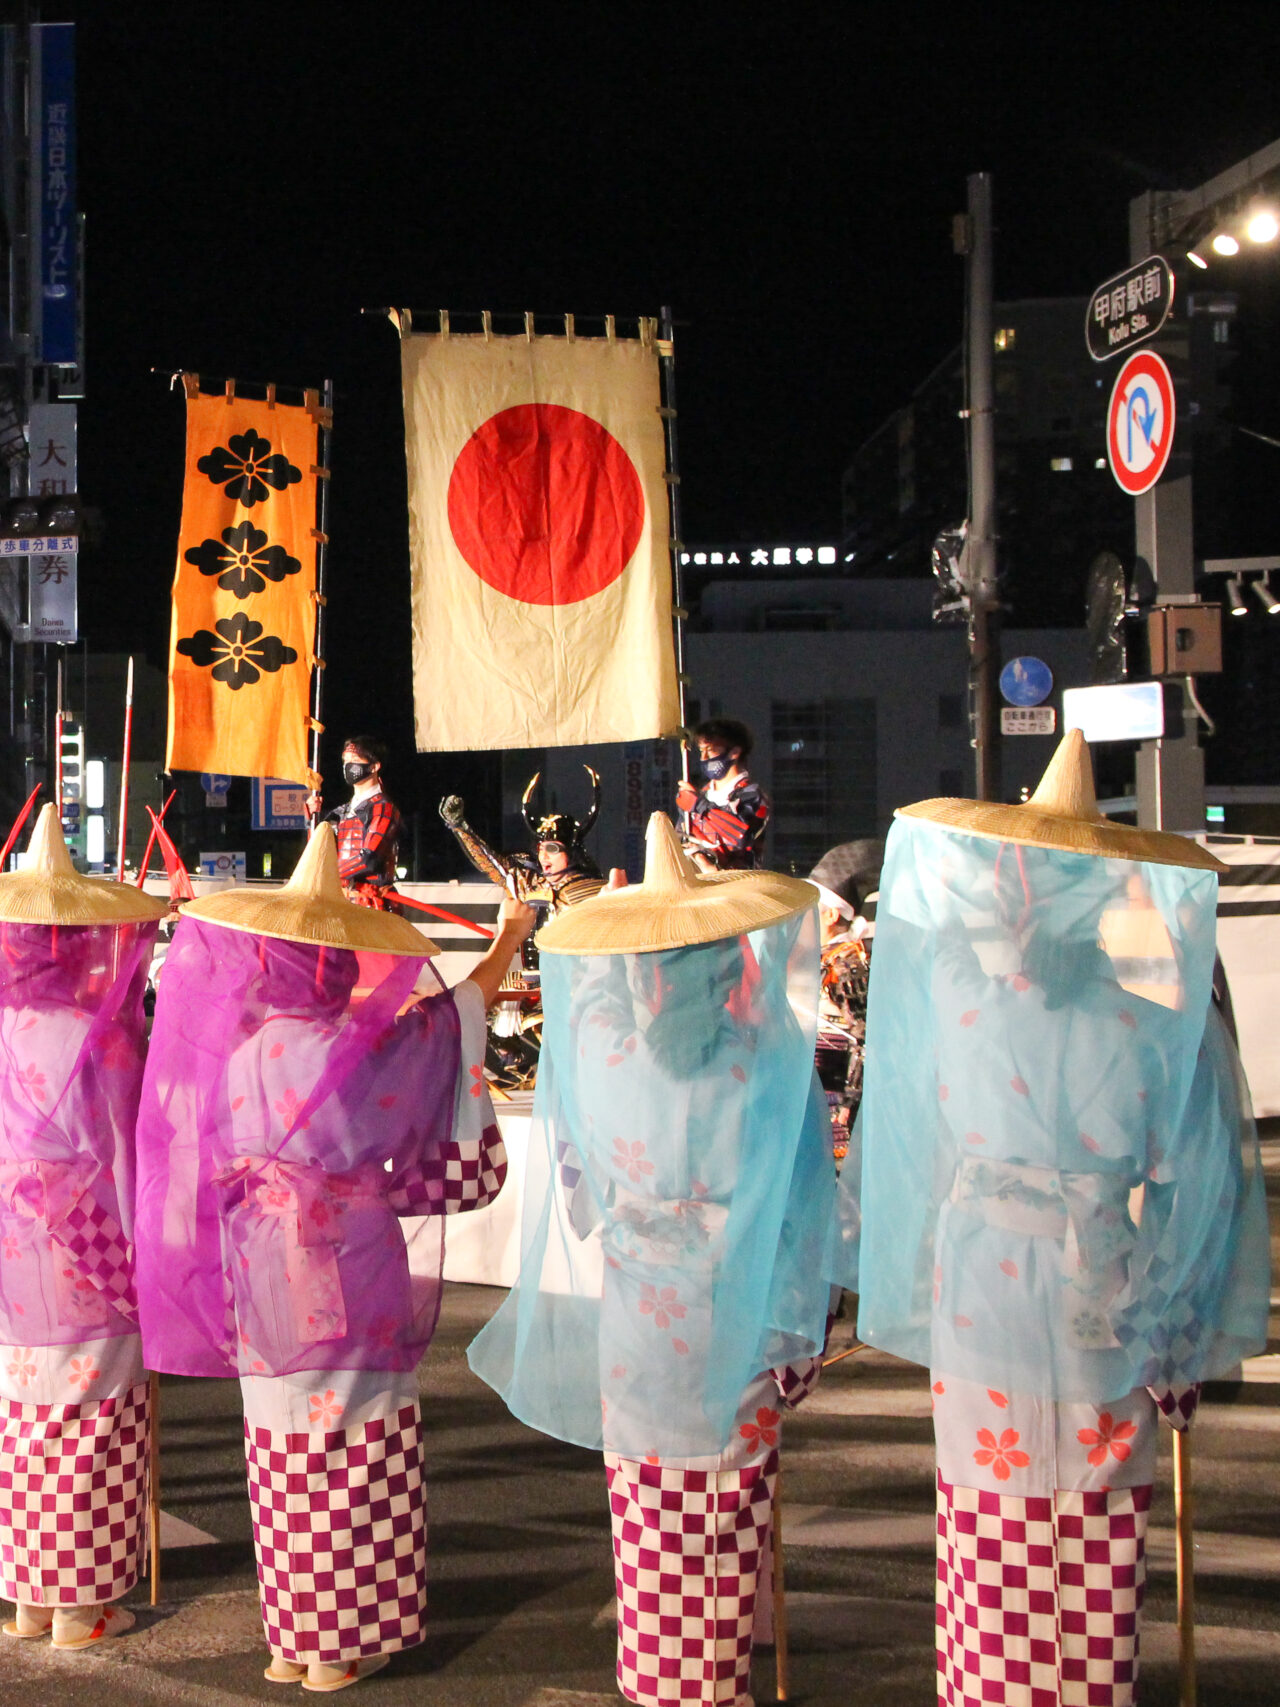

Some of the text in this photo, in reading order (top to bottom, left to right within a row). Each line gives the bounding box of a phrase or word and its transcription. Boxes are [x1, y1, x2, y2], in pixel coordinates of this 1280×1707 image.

[1094, 265, 1161, 328] 甲府駅前
[1108, 322, 1130, 346] Kofu
[38, 438, 69, 585] 大和券
[4, 536, 73, 553] 歩車分離式
[1006, 721, 1049, 733] ここから
